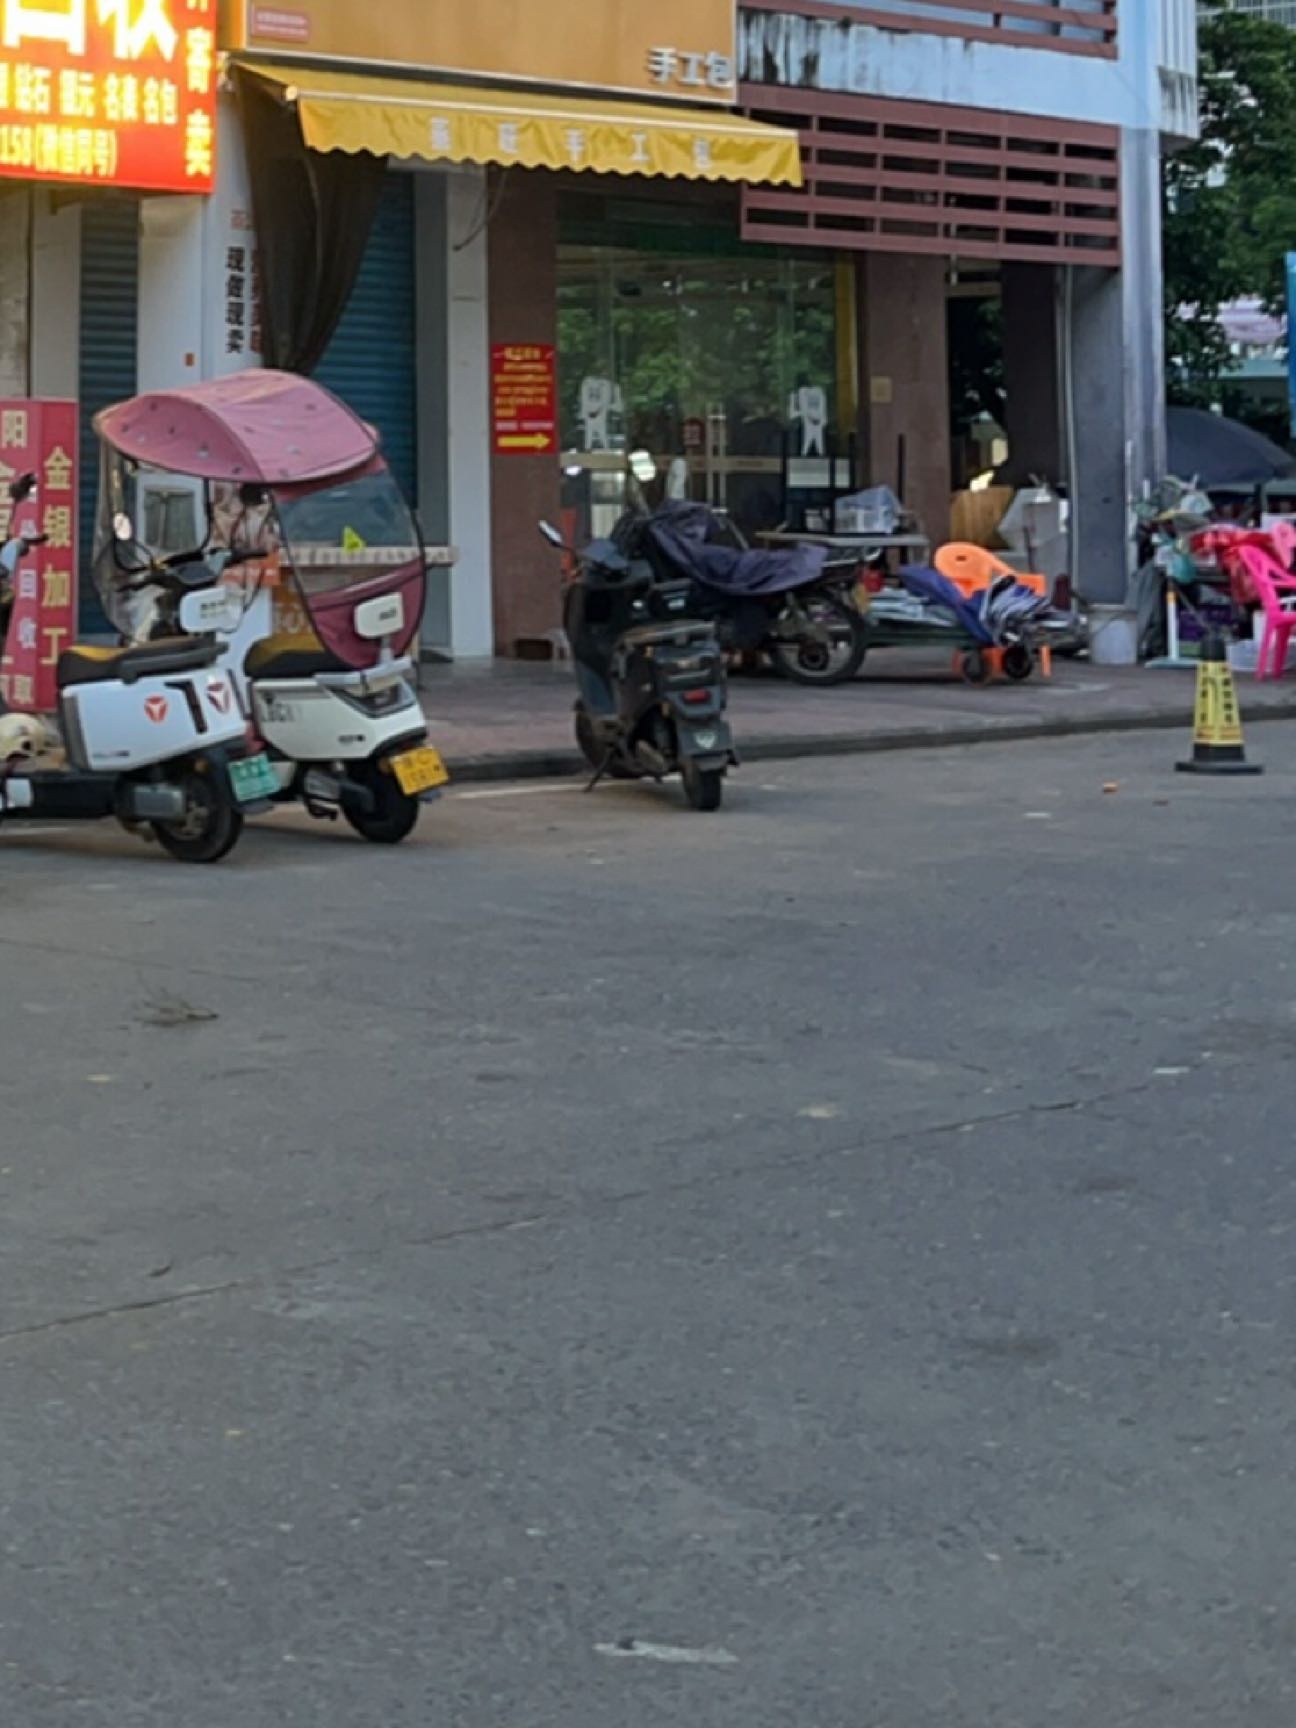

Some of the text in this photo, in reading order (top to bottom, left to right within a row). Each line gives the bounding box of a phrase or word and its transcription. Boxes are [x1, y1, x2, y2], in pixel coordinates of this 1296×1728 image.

[646, 47, 734, 89] 手工包
[42, 446, 72, 665] 金银加工
